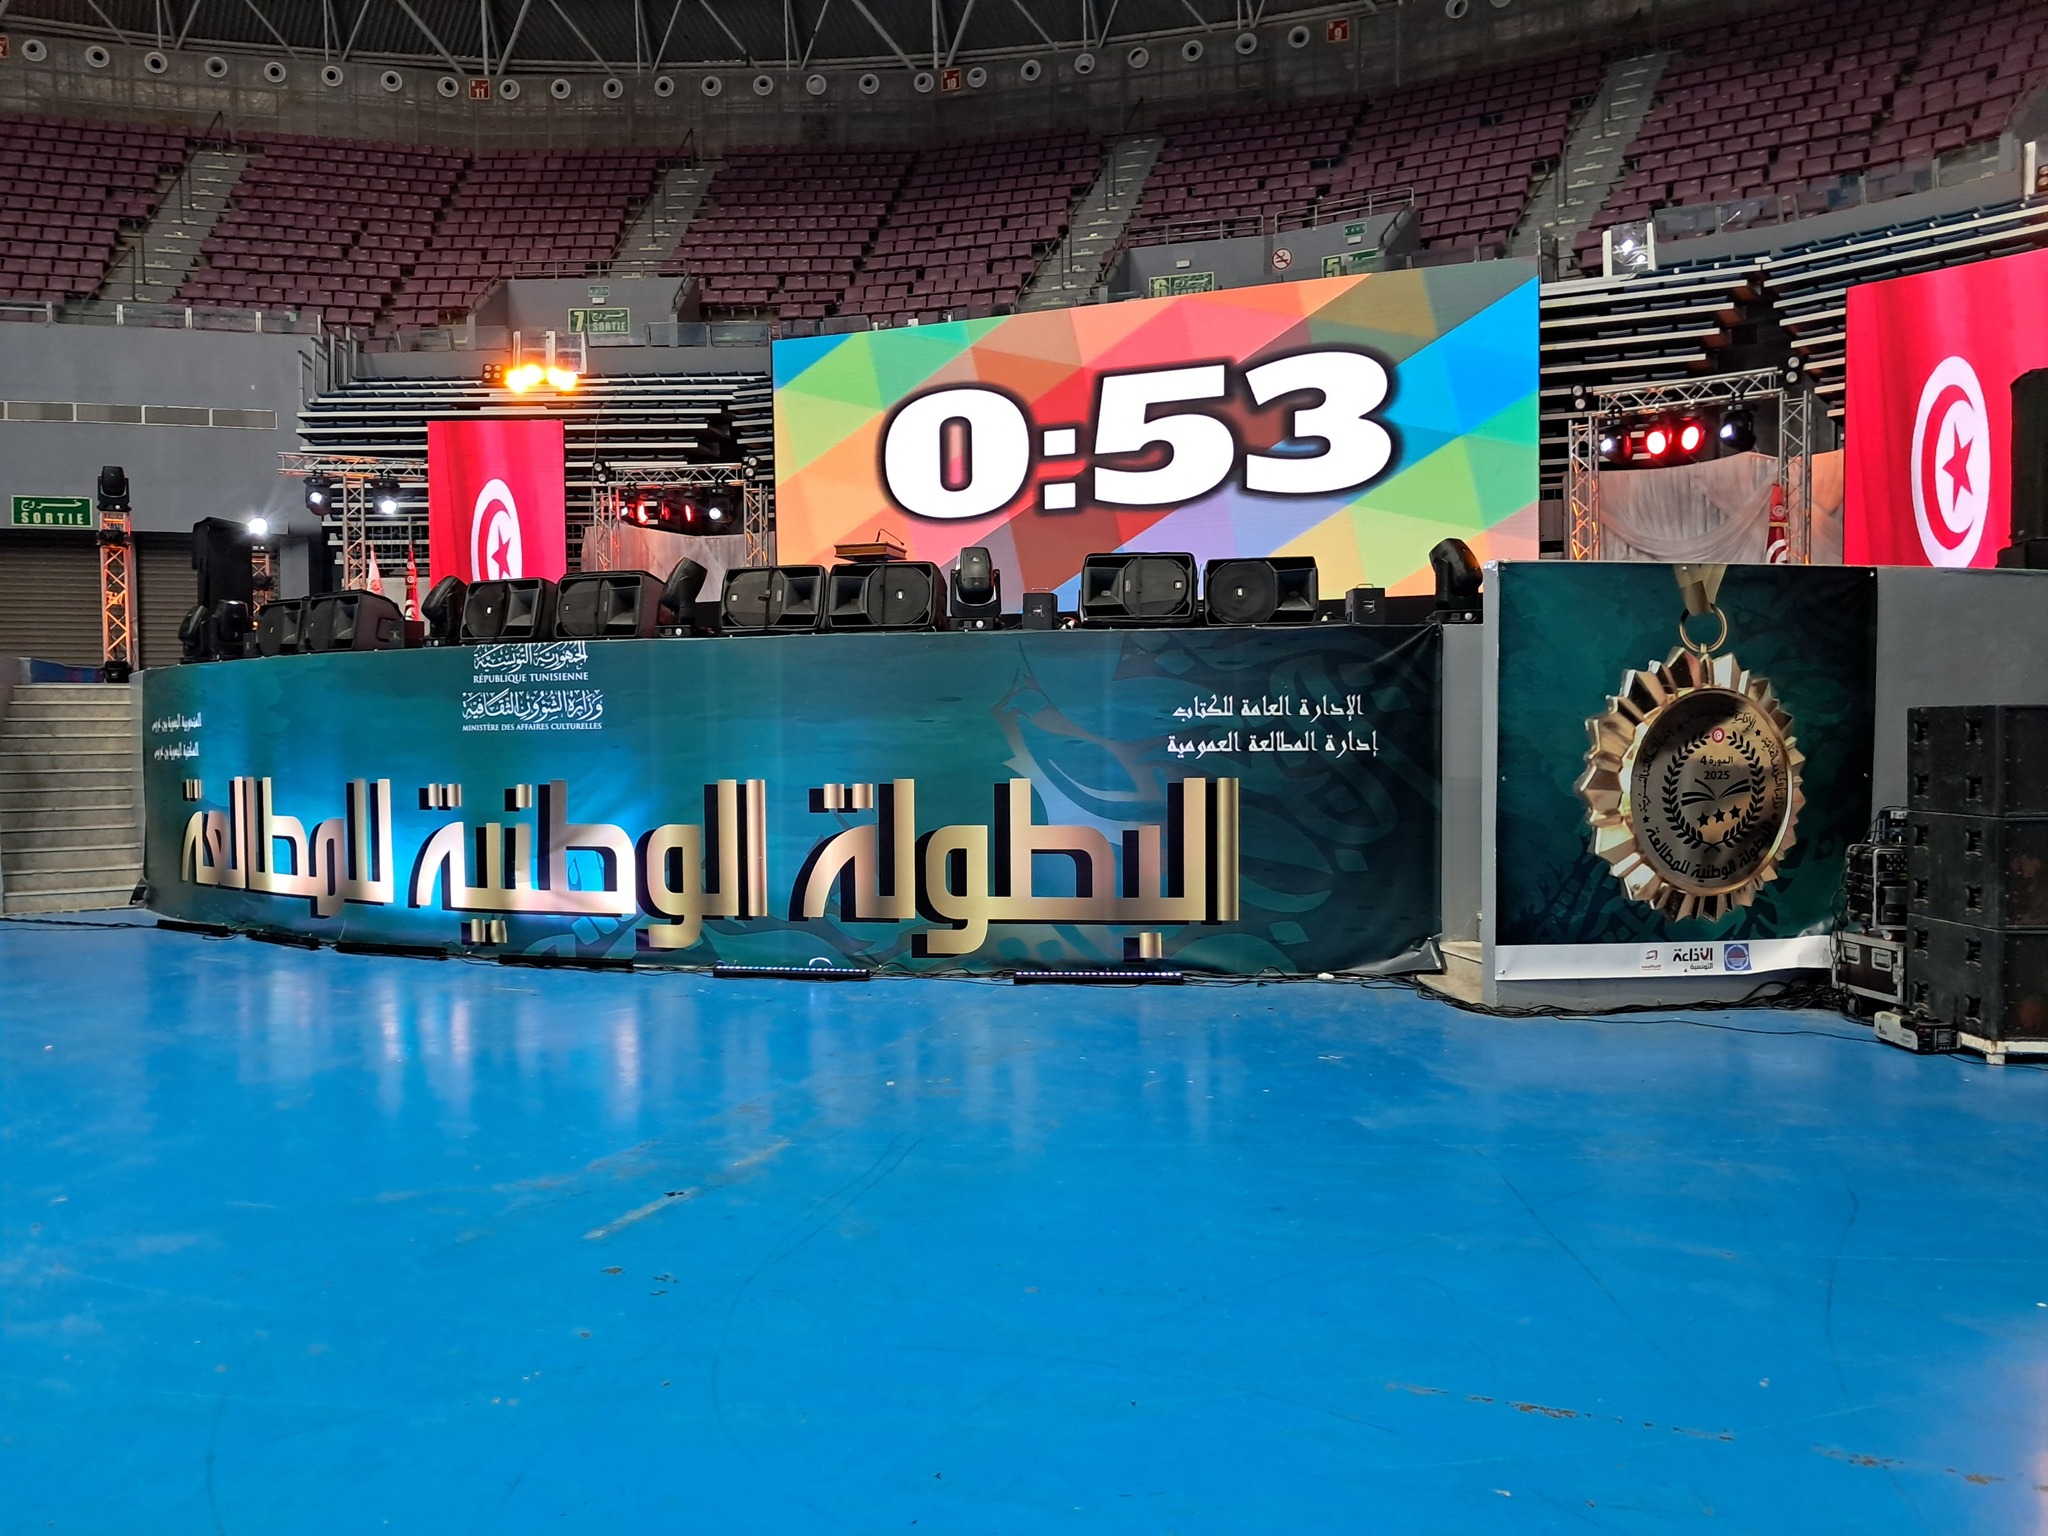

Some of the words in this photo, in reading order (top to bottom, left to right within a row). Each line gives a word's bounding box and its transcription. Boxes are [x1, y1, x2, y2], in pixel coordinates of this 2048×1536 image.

[1334, 27, 1343, 40] 9
[475, 87, 485, 98] 11
[1326, 257, 1341, 278] 5
[1153, 278, 1168, 298] 6
[573, 311, 585, 332] 7
[591, 310, 626, 322] خروج
[592, 321, 627, 332] SORTIE
[884, 350, 1393, 520] 0:53
[20, 499, 83, 512] خروج
[20, 511, 84, 525] SORTIE
[473, 673, 527, 685] RÉPUBLIQUE
[529, 672, 589, 682] TUNISIENNE
[1171, 693, 1234, 723] للكتاب
[1240, 694, 1293, 717] العامة
[1299, 694, 1364, 723] الإدارة
[462, 722, 500, 732] MINISTÈRE
[501, 723, 515, 731] DES
[516, 722, 549, 731] AFFAIRES
[550, 722, 603, 731] CULTURELLES
[1167, 730, 1242, 760] العمومية
[1247, 730, 1318, 752] المطالعة
[1324, 729, 1380, 759] إدارة
[1699, 755, 1708, 766] 4
[1708, 755, 1734, 768] الدورة
[1703, 769, 1731, 781] 2025
[178, 776, 395, 917] للمطالعة
[1644, 826, 1691, 875] للمطالعة
[410, 778, 768, 949] الوطنية
[800, 777, 1240, 959] البطولة
[1691, 860, 1737, 883] الوطنية
